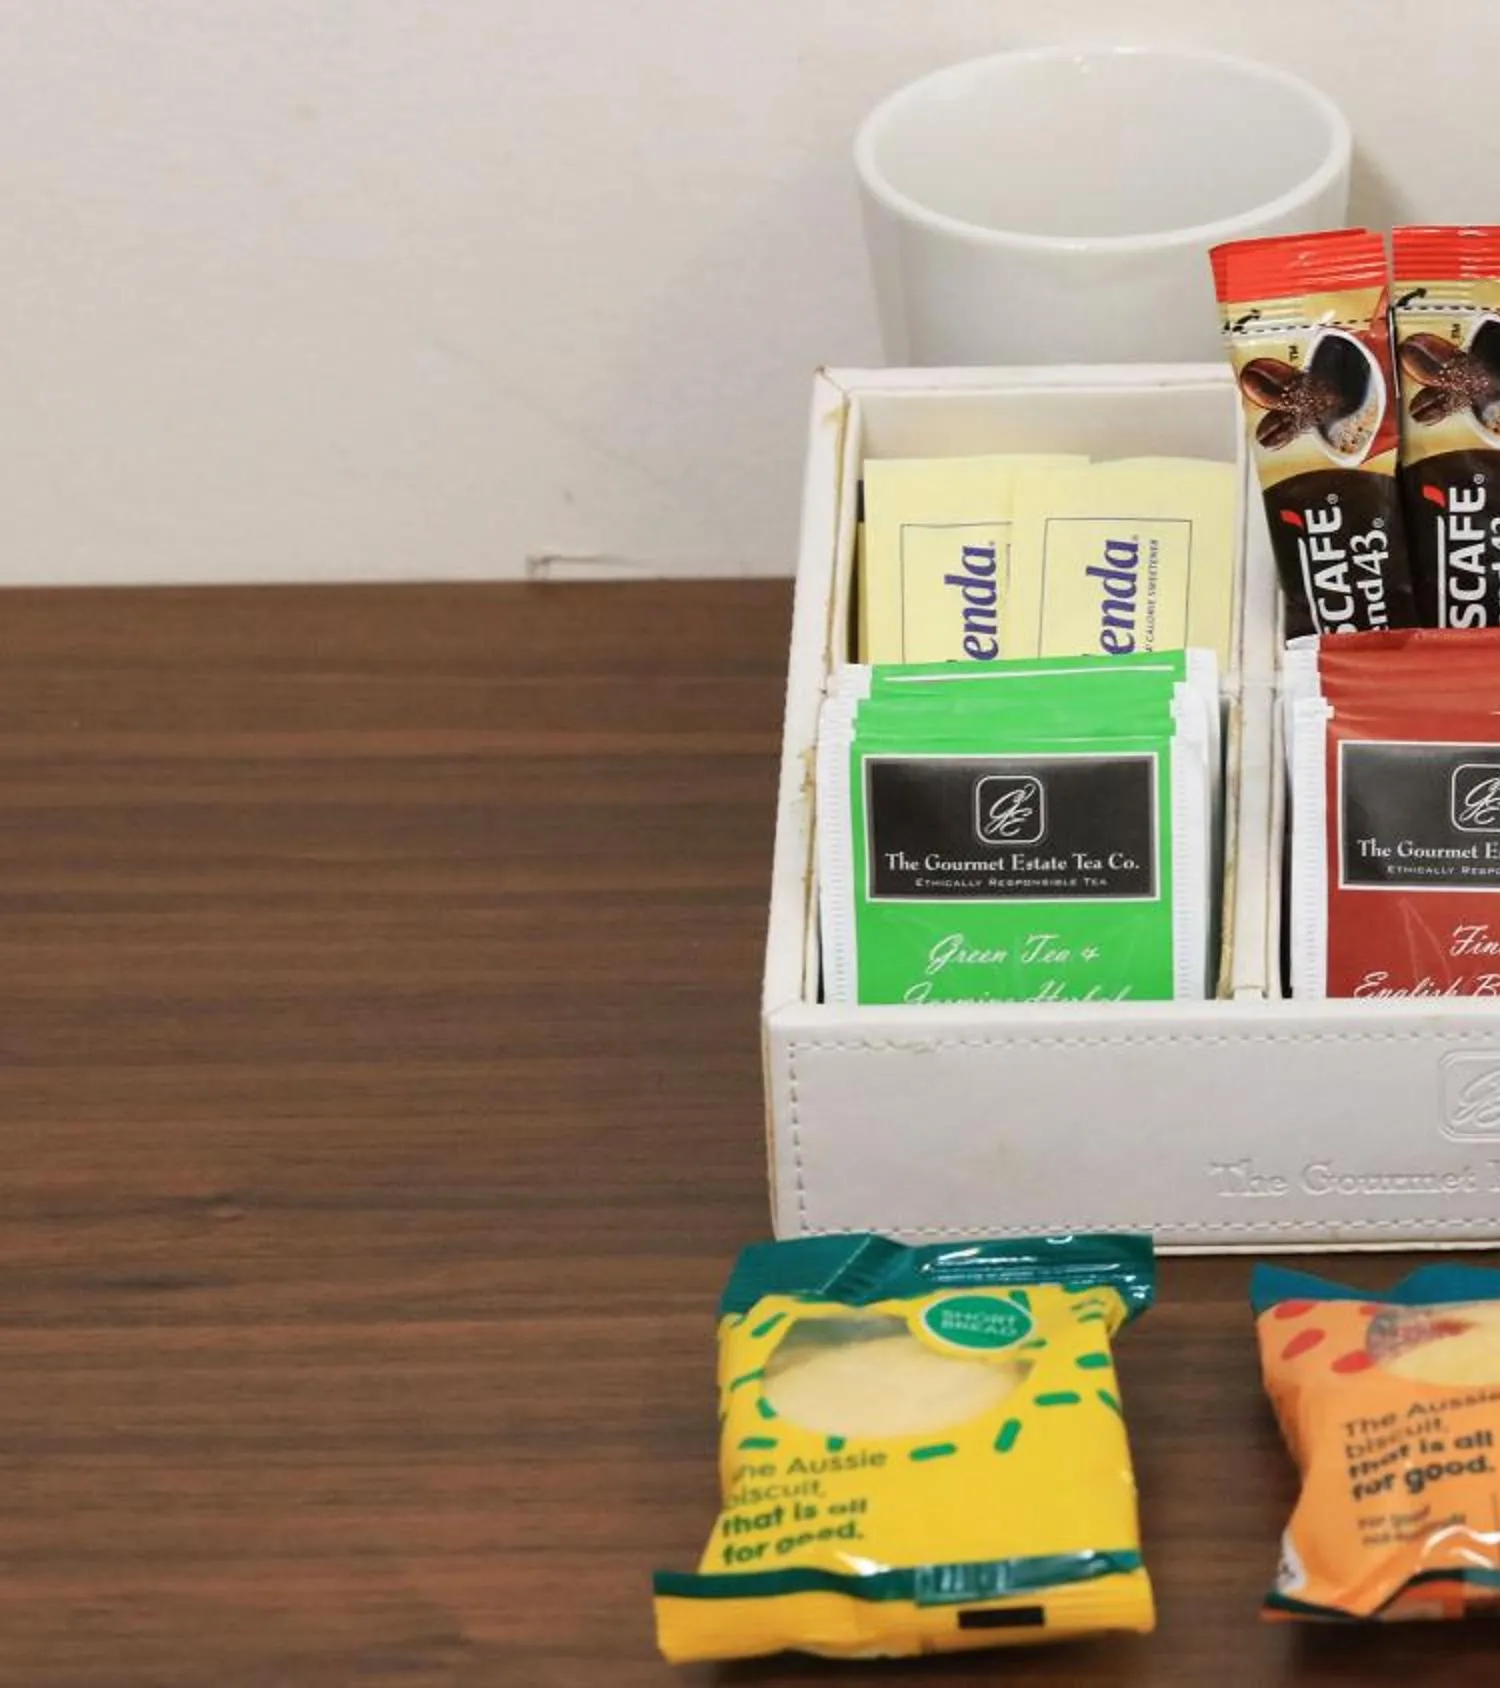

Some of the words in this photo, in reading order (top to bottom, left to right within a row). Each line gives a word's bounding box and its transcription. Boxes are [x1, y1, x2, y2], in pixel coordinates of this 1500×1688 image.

[943, 545, 1000, 662] enda
[1085, 538, 1140, 657] enda
[885, 852, 921, 872] The
[924, 853, 1005, 873] Gourmet
[1011, 854, 1068, 872] Estate
[1072, 853, 1103, 872] Tea
[1108, 852, 1141, 871] Co.
[1357, 838, 1393, 859] The
[1397, 841, 1479, 861] Gourmet
[926, 933, 1008, 975] Green
[1022, 933, 1072, 966] Tea
[1209, 1158, 1289, 1197] The
[1300, 1162, 1478, 1196] Gourmet
[1453, 1429, 1494, 1451] all
[786, 1449, 888, 1475] Aussie
[793, 1502, 818, 1522] is
